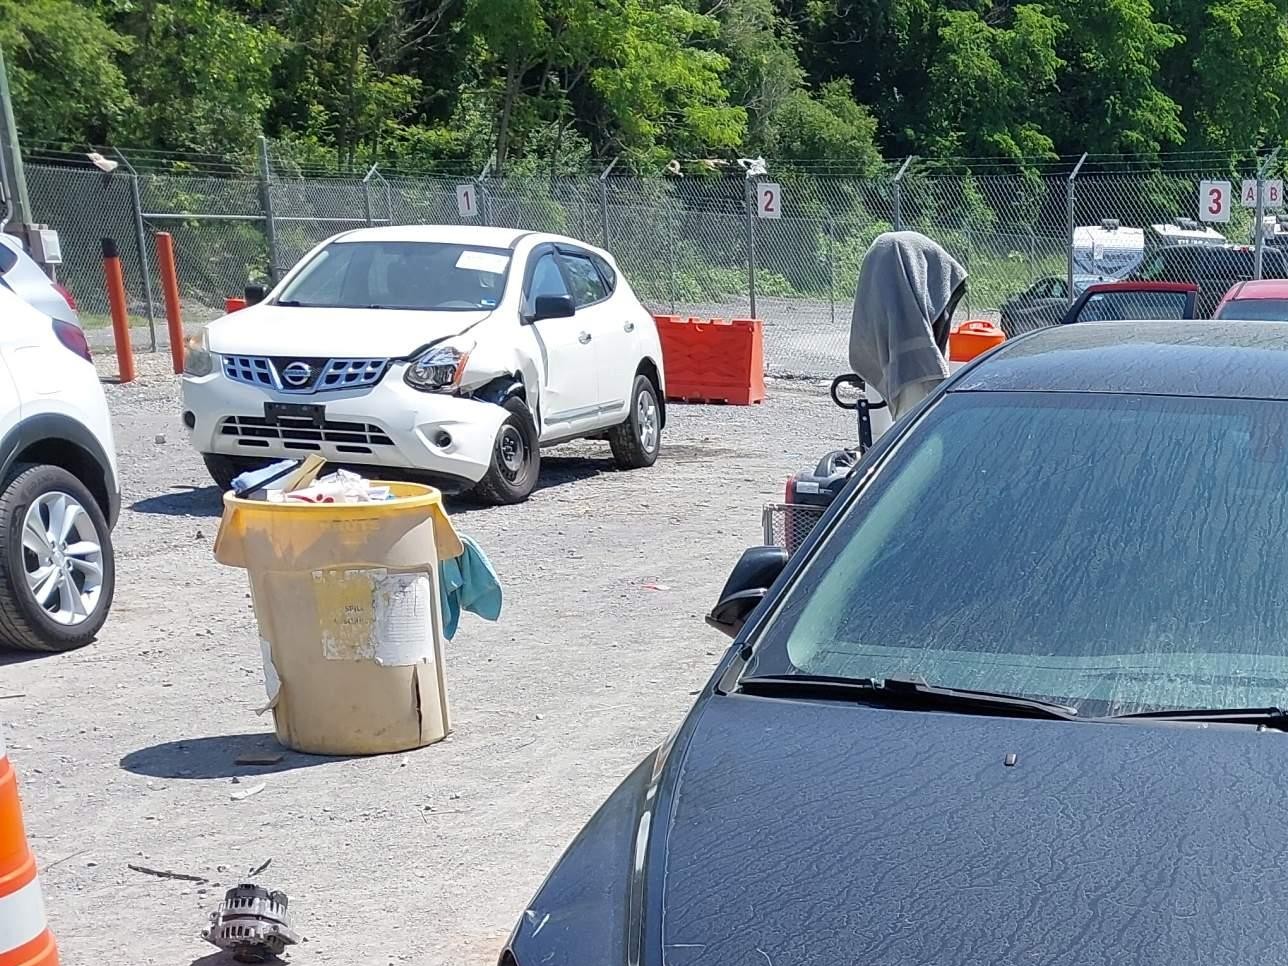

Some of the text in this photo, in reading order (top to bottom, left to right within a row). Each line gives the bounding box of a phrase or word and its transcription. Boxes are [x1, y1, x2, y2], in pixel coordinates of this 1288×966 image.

[463, 191, 471, 211] 1
[763, 190, 775, 212] 2
[1208, 188, 1222, 215] 3
[1245, 187, 1255, 201] A
[1270, 187, 1278, 201] B
